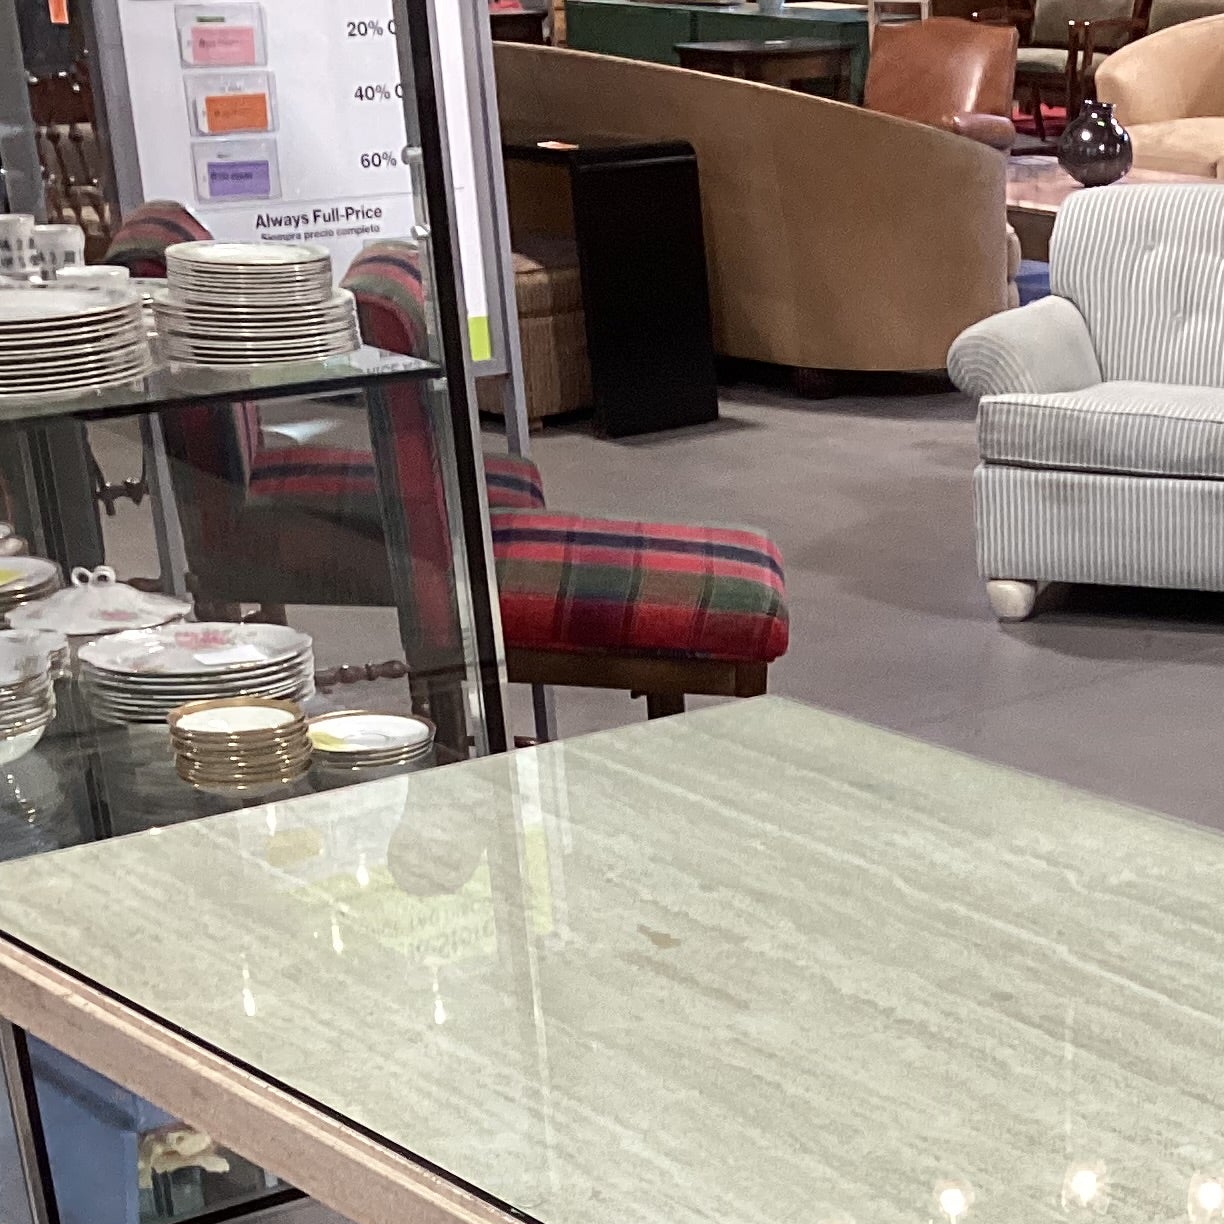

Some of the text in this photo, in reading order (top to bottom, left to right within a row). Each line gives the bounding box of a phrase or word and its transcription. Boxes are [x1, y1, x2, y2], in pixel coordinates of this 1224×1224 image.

[346, 20, 384, 39] 20%
[354, 84, 391, 102] 40%
[360, 151, 397, 170] 60%
[256, 205, 382, 228] Always Full-Price
[304, 228, 334, 241] precio
[336, 224, 380, 237] completo
